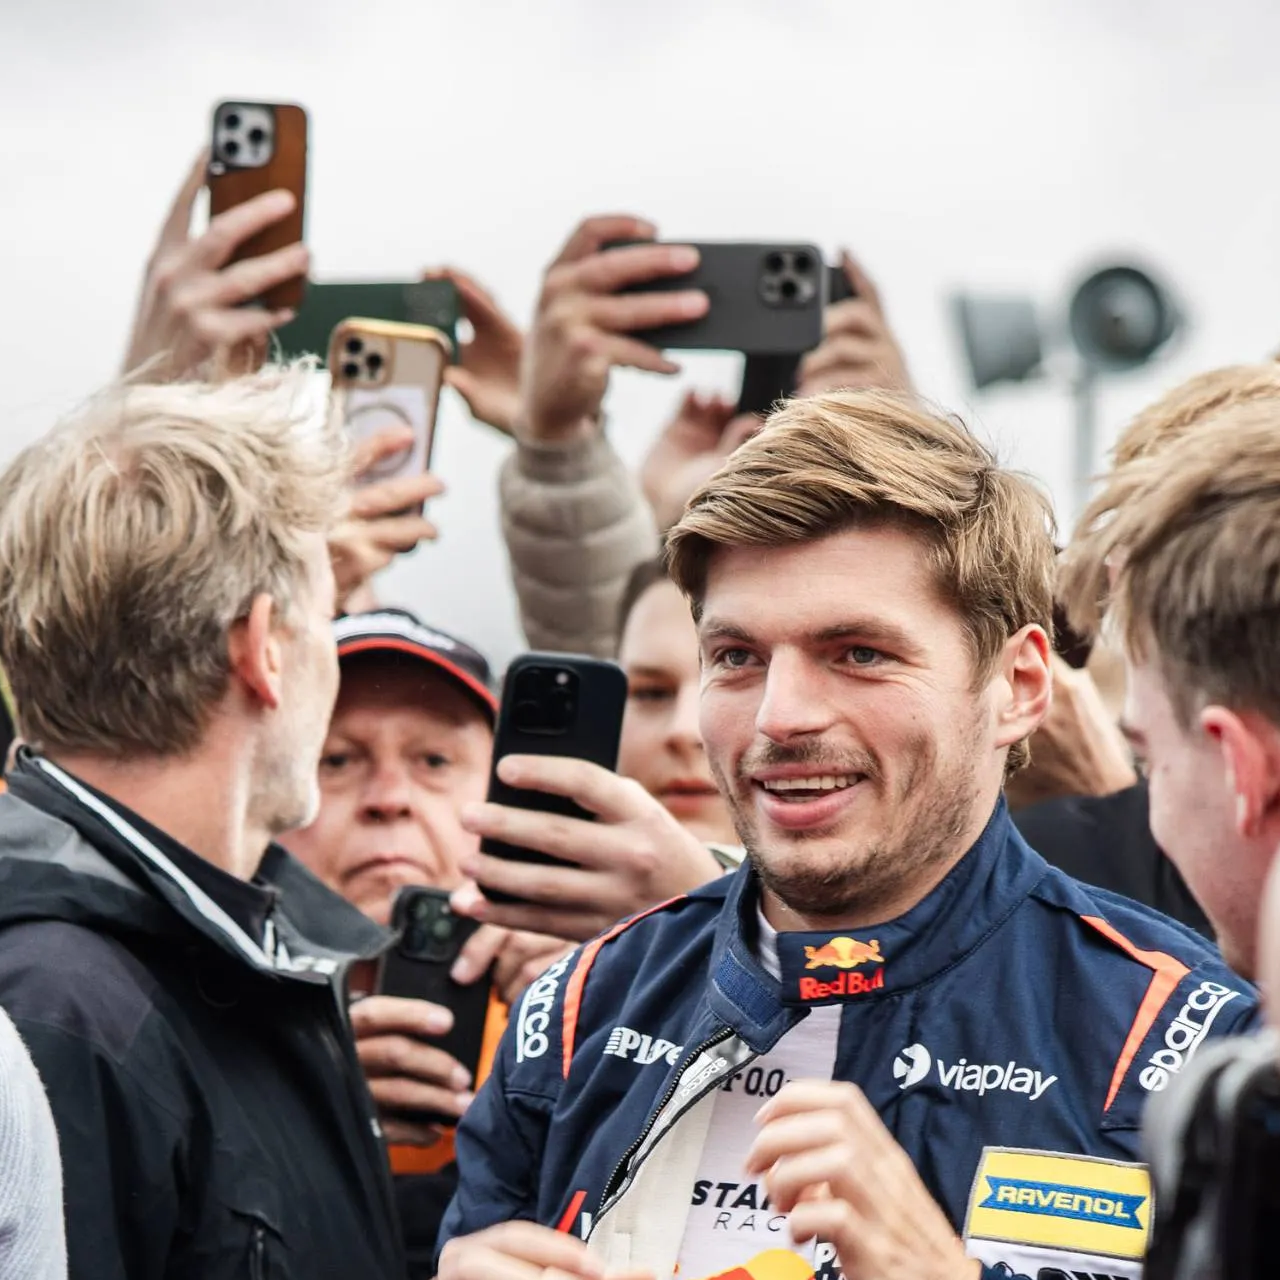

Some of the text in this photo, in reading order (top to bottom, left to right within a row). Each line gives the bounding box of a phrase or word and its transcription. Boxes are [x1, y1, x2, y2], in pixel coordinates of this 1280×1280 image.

[799, 968, 884, 1000] Red Bull
[1139, 981, 1236, 1092] sparco
[936, 1058, 1058, 1101] viaplay
[996, 1186, 1130, 1219] RAVENOL
